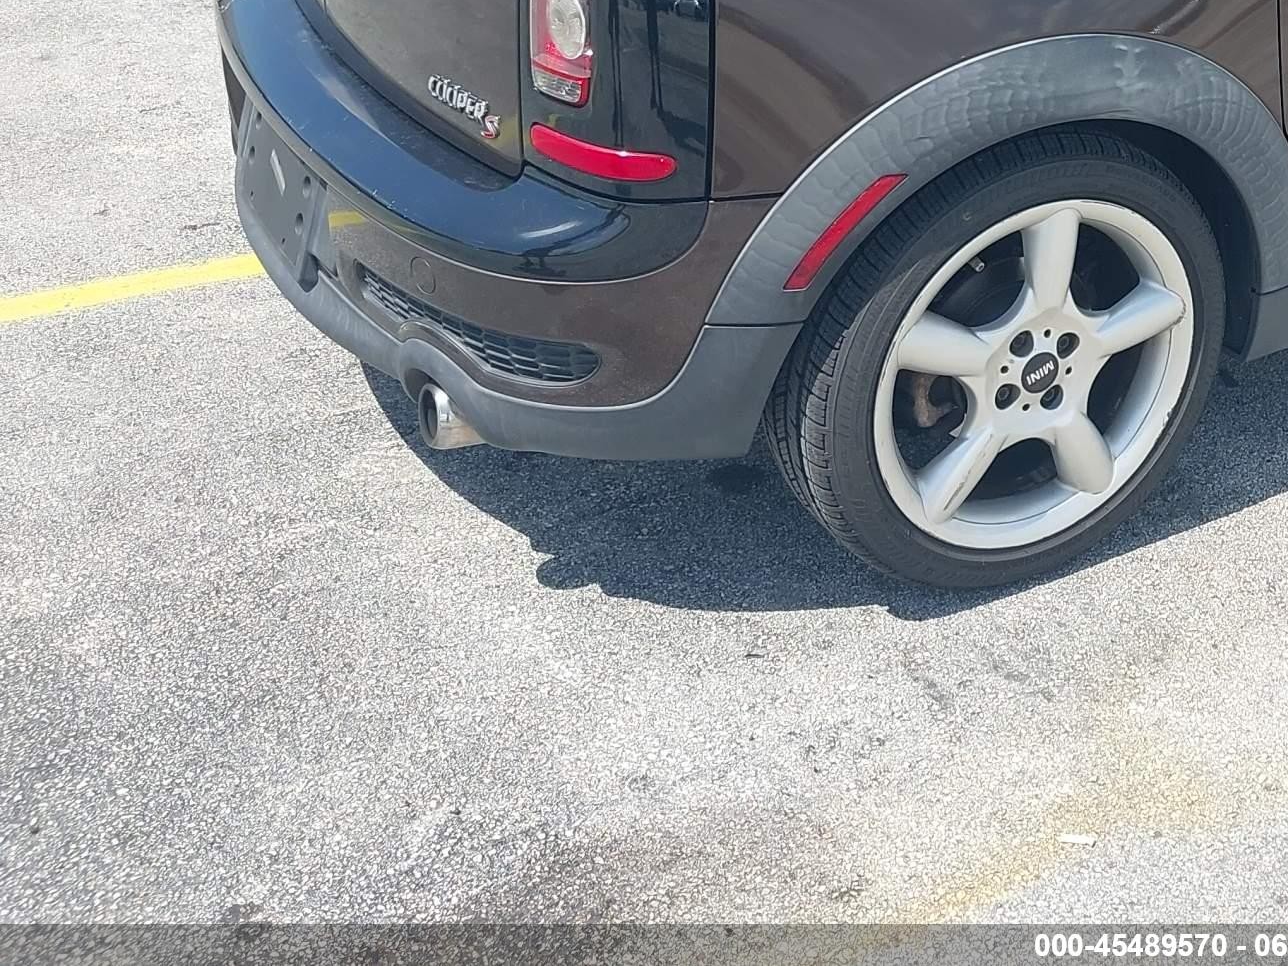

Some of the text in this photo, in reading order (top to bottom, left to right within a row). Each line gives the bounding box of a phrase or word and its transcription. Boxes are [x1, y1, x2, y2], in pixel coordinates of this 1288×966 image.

[427, 74, 500, 139] COOPER S
[1026, 360, 1055, 386] MINI
